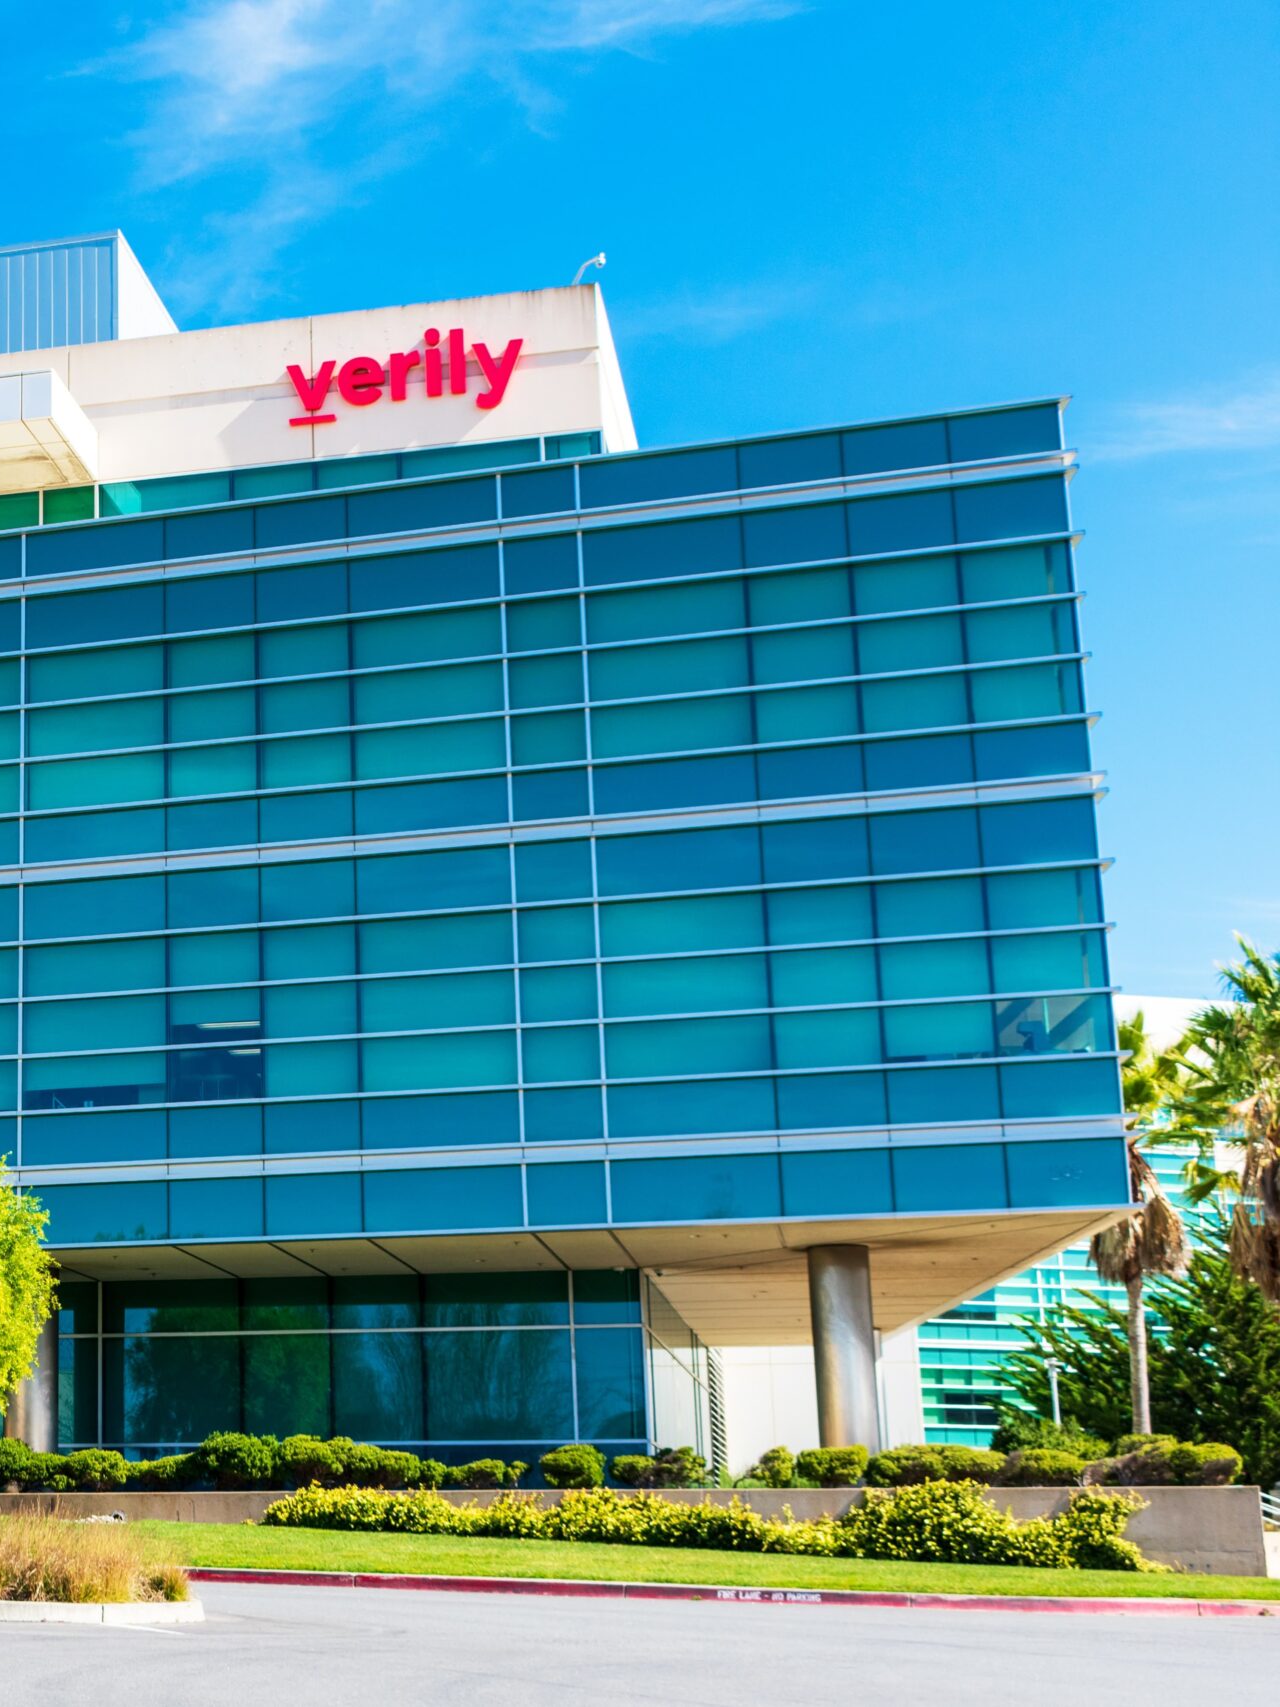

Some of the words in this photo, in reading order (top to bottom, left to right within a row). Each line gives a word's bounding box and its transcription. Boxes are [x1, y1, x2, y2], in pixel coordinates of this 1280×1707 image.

[286, 328, 523, 426] verily
[717, 1590, 736, 1599] FIRE
[738, 1591, 762, 1600] LANE
[786, 1593, 821, 1602] PARKING
